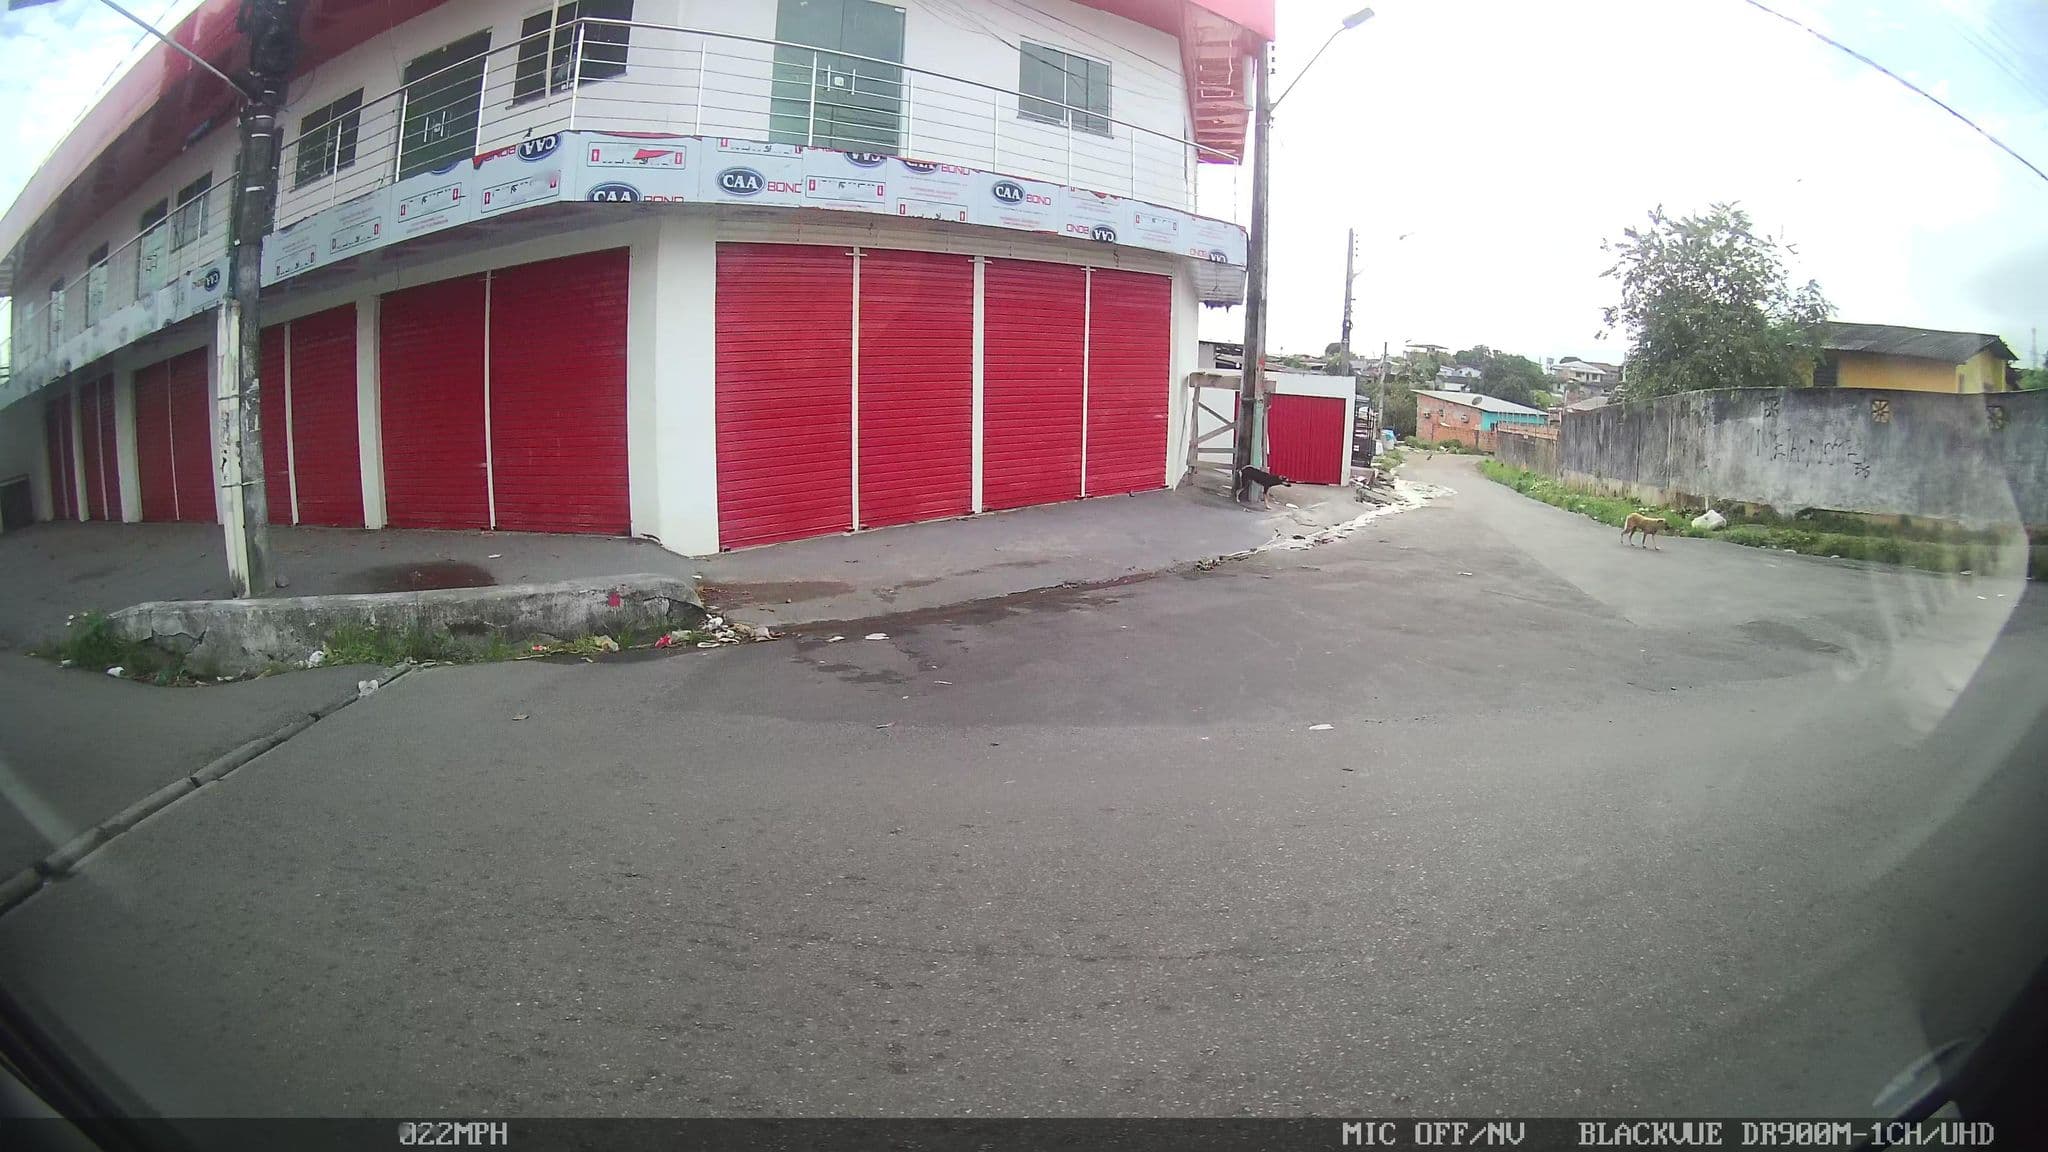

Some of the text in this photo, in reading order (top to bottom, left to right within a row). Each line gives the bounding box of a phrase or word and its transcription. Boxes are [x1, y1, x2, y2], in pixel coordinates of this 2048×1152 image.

[723, 174, 760, 190] CAA
[593, 190, 632, 202] CAA
[995, 185, 1052, 206] CAA BOND
